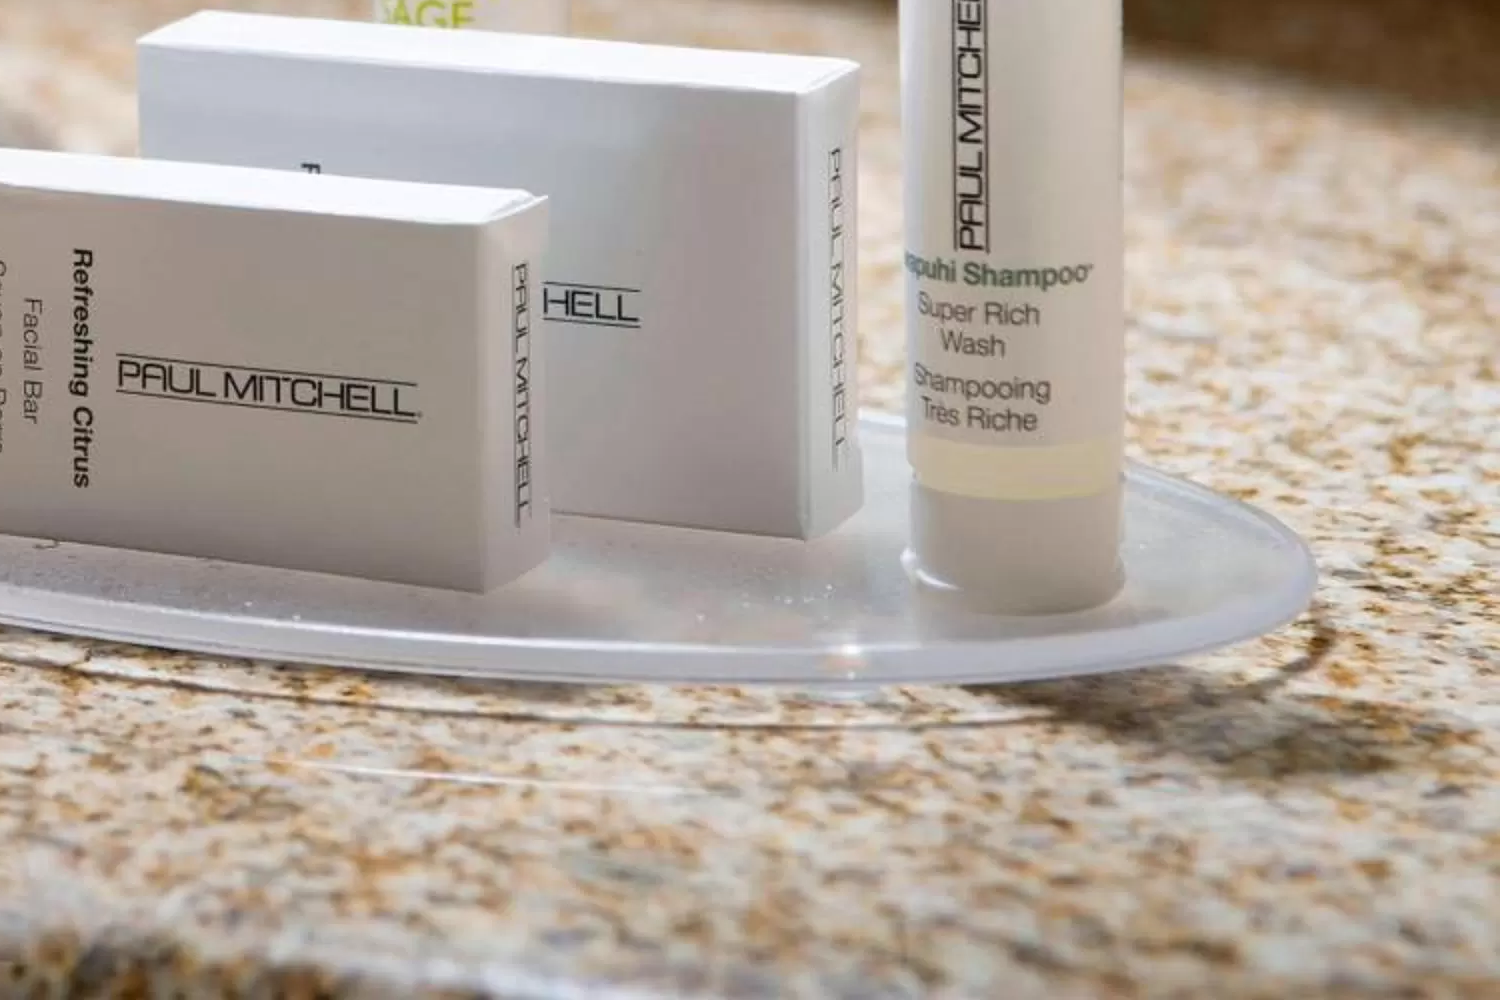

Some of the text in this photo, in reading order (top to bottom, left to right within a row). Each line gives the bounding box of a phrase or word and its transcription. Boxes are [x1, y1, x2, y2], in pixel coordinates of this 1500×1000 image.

[958, 151, 984, 251] PAUL
[543, 287, 639, 321] HELL
[917, 291, 1040, 326] Super Rich
[23, 298, 43, 424] Facial Bar
[940, 328, 1006, 358] Wash
[69, 248, 94, 488] Refreshing Citrus
[118, 359, 416, 416] PAUL MITCHELL
[915, 362, 1052, 404] Shampooing
[515, 263, 530, 524] PAUL MITCHELL
[921, 396, 1038, 432] Très Riche
